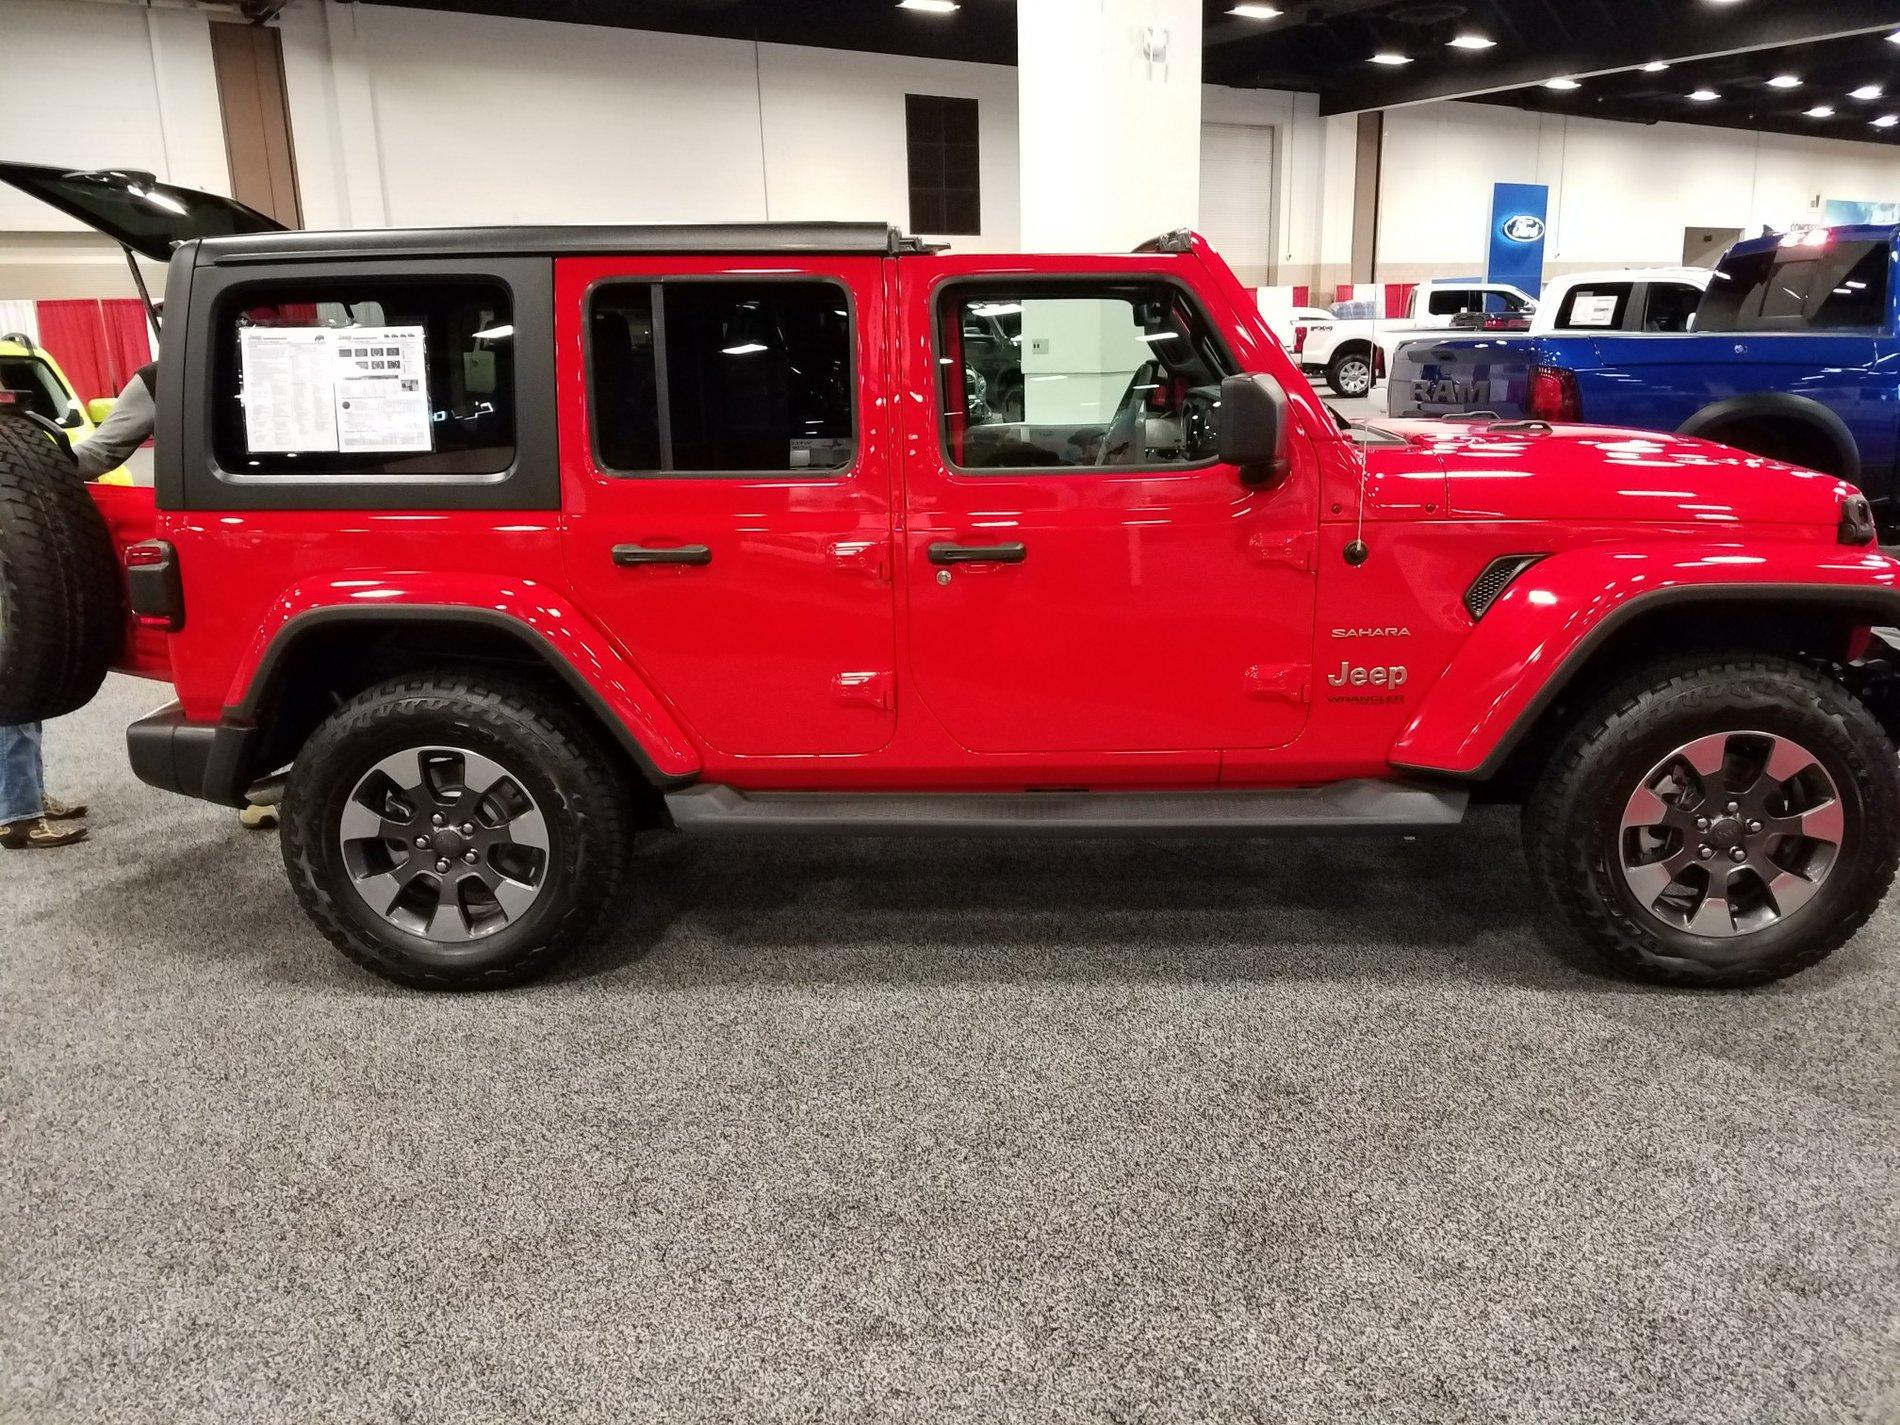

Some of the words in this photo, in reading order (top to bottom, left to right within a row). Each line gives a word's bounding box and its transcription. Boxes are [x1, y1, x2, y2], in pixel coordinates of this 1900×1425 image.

[1409, 379, 1491, 404] RAM
[1331, 627, 1411, 638] SAHARA
[1327, 661, 1408, 690] Jeep
[1327, 695, 1406, 705] WRANGLER
